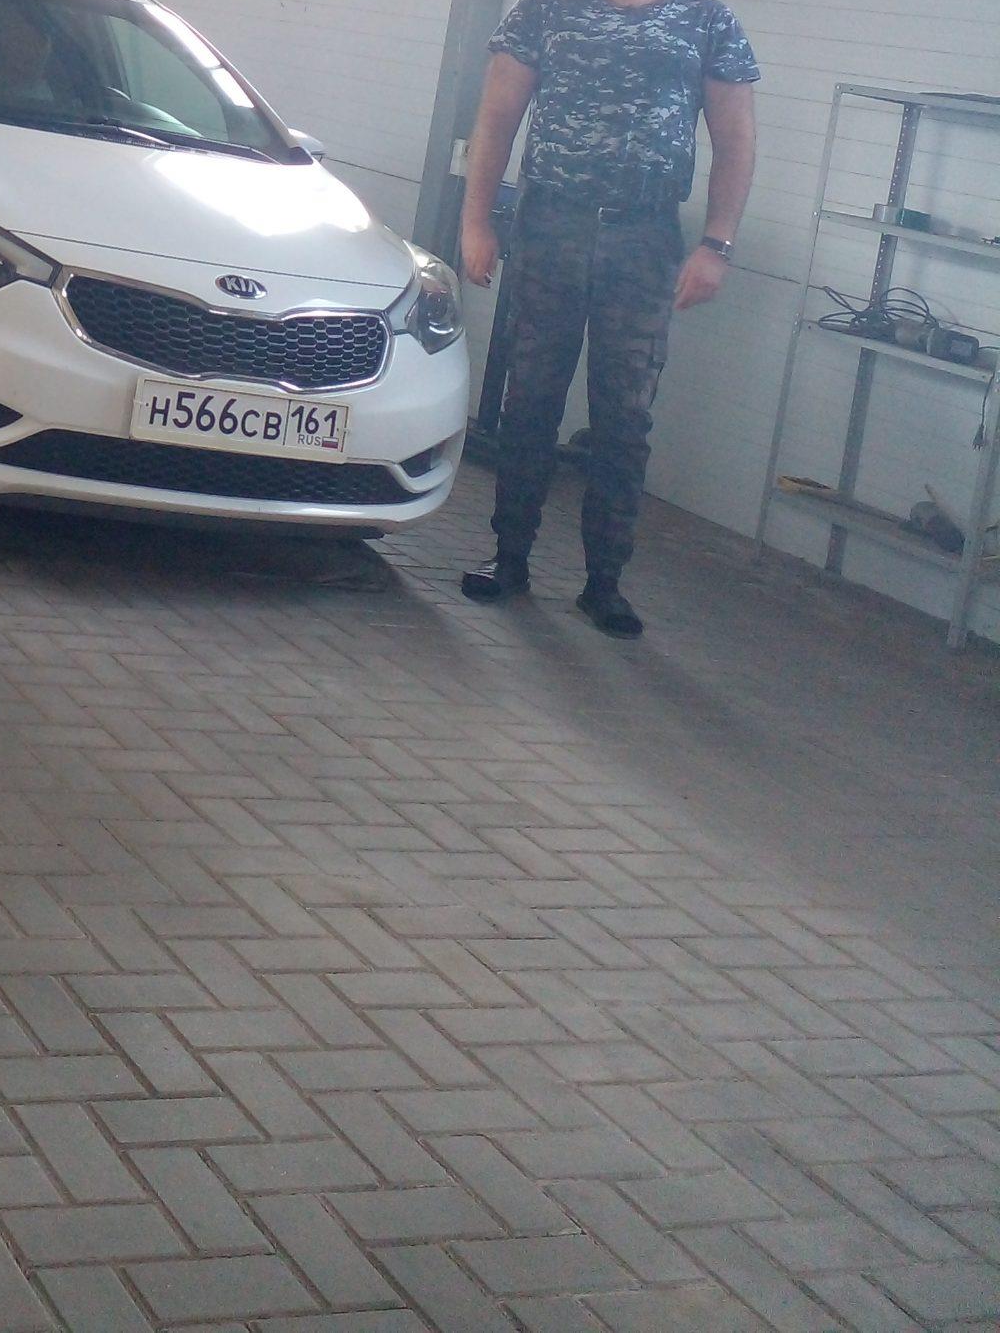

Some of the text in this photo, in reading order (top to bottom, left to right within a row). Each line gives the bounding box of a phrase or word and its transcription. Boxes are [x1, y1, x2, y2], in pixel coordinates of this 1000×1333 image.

[224, 277, 261, 294] KIA
[291, 405, 337, 437] 161
[297, 434, 321, 446] RUS
